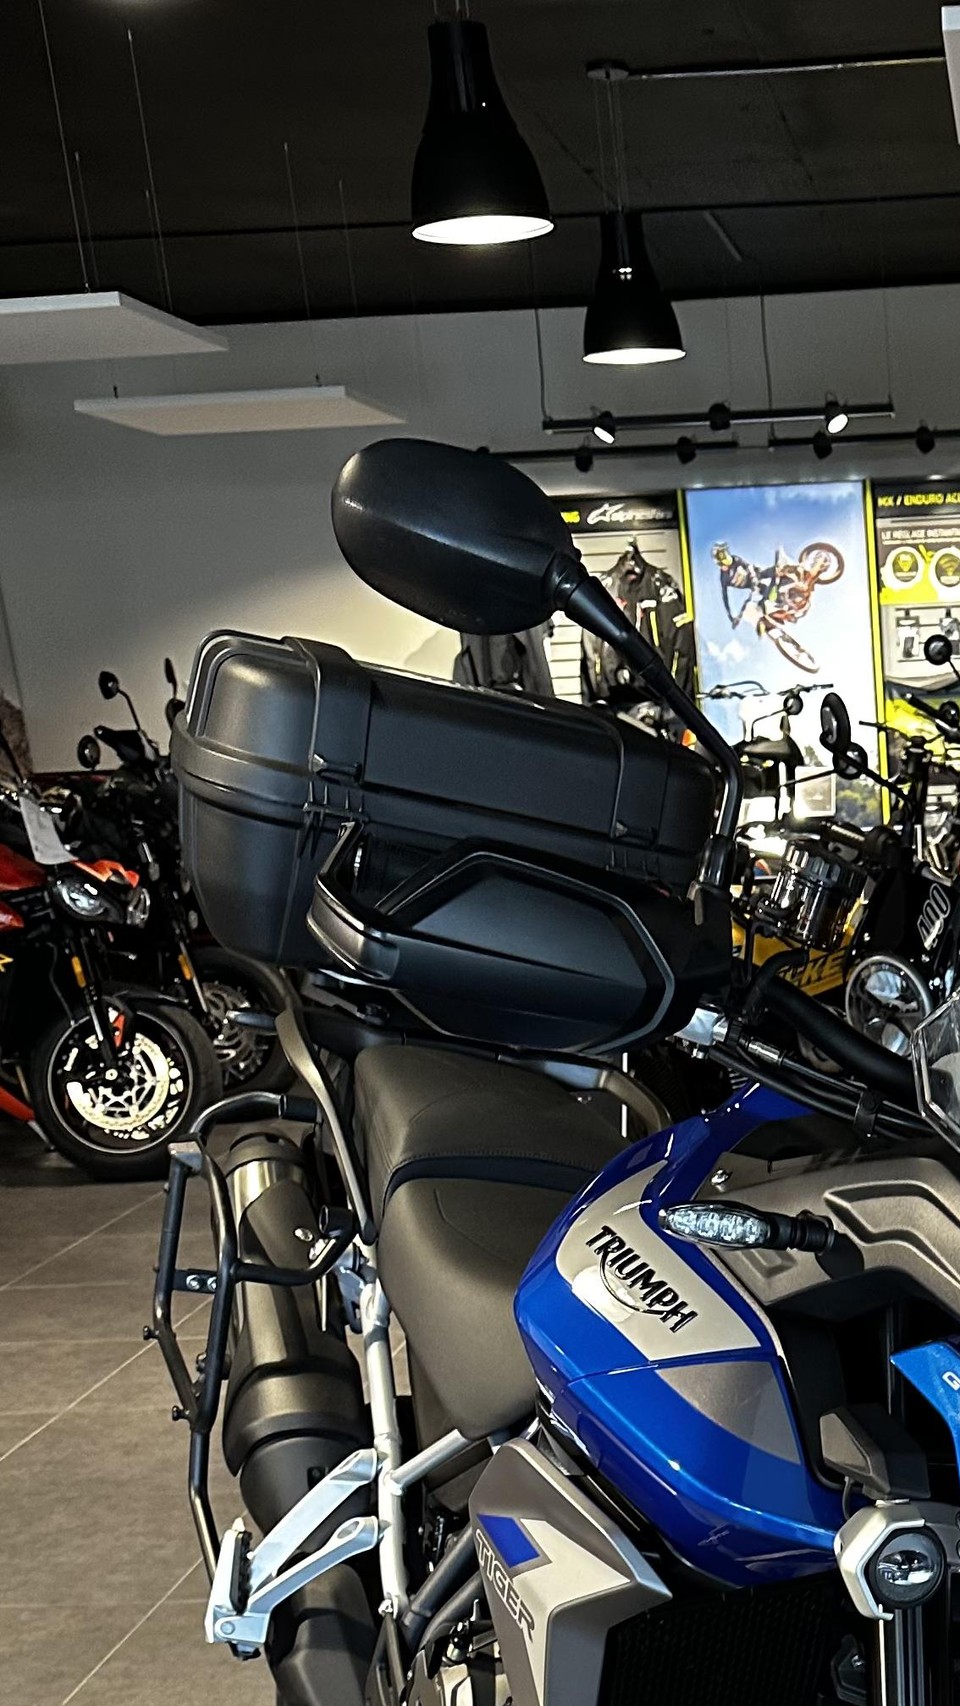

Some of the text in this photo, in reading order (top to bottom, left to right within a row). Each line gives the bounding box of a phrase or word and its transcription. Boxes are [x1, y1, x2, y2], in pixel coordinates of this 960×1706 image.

[903, 493, 944, 506] ENDURO
[916, 883, 951, 950] 400
[585, 1225, 699, 1334] TRIUMPH
[475, 1528, 536, 1643] TIGER
